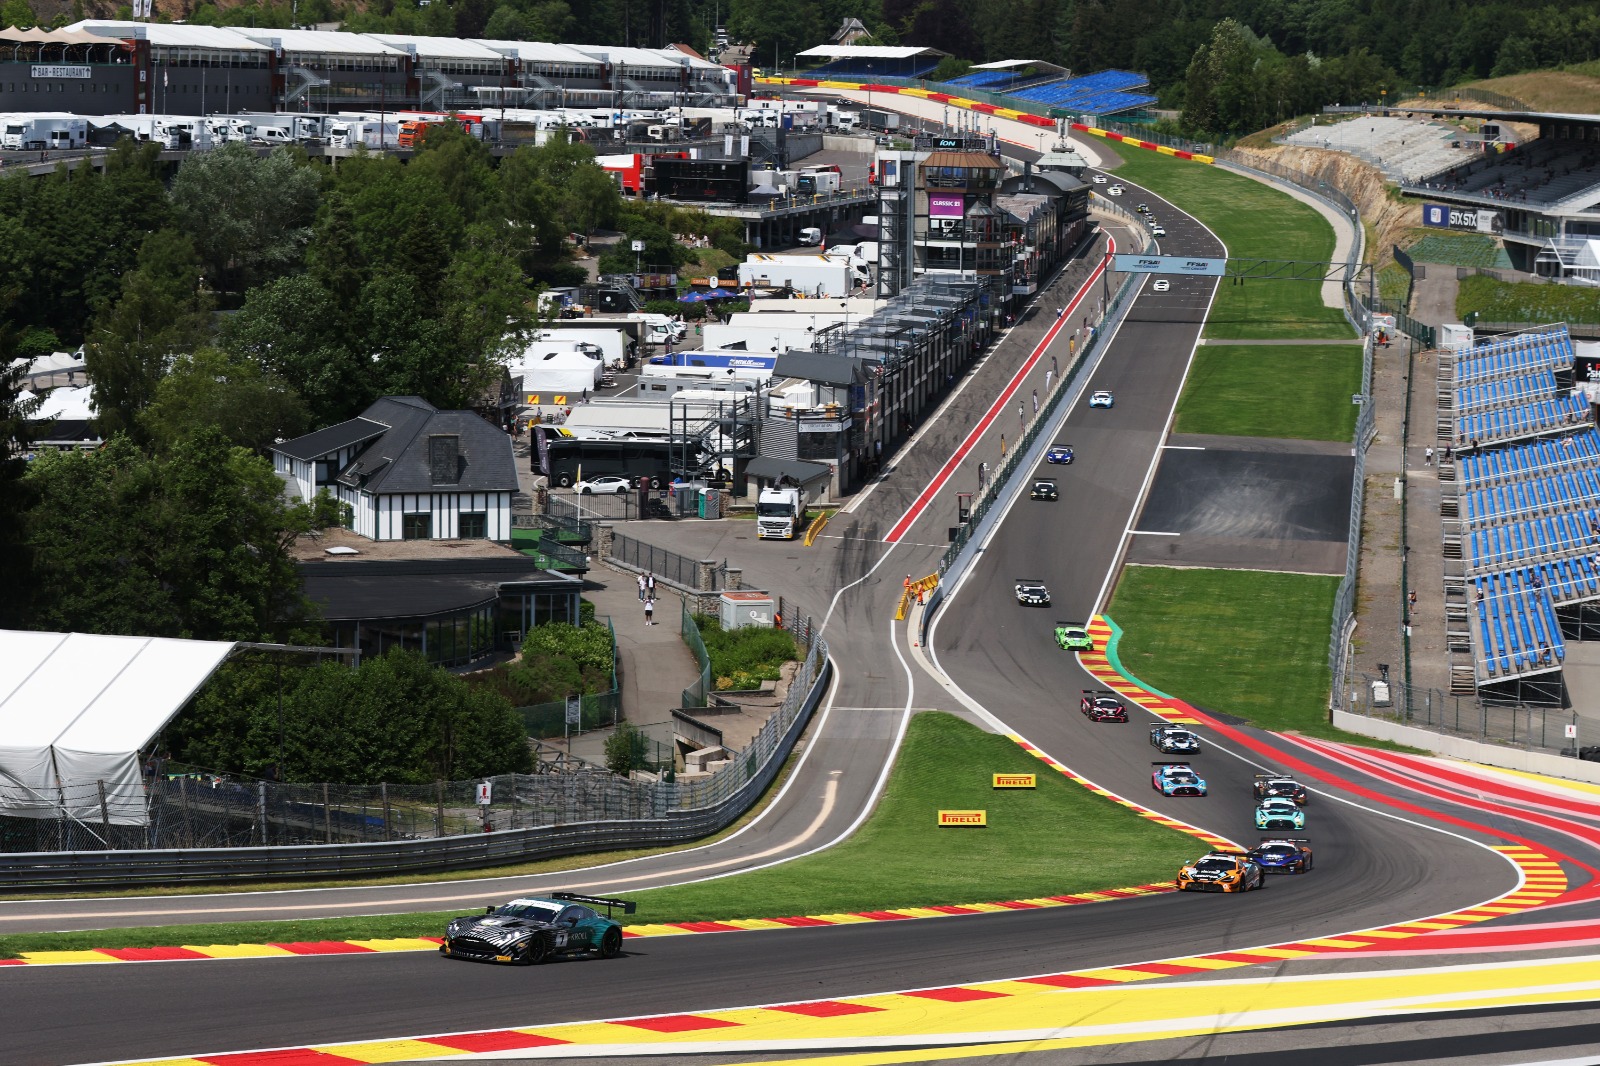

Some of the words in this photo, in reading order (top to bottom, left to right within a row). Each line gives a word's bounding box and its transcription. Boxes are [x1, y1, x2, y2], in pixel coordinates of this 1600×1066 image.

[996, 776, 1032, 784] PIRELLI
[942, 814, 981, 822] PIRELLI
[560, 934, 564, 944] 7
